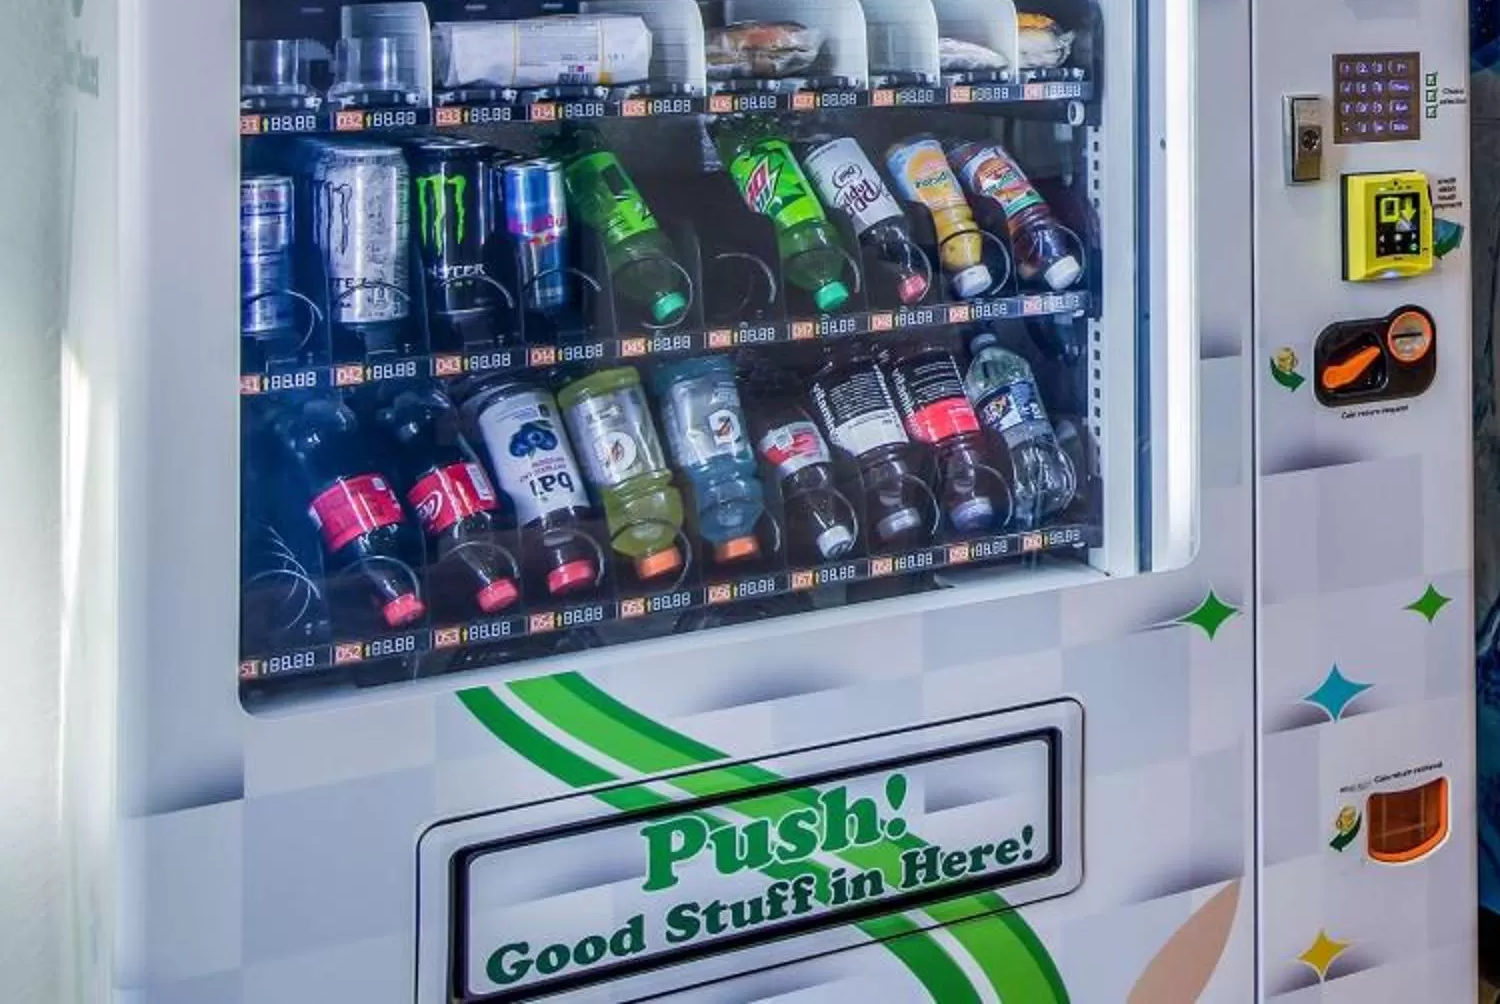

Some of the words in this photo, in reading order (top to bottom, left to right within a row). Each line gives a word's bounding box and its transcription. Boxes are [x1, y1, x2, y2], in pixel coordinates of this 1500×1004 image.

[640, 772, 910, 893] Push!
[485, 913, 647, 986] Good
[664, 877, 815, 945] Stuff
[829, 865, 886, 906] in
[899, 824, 1036, 891] Here!
